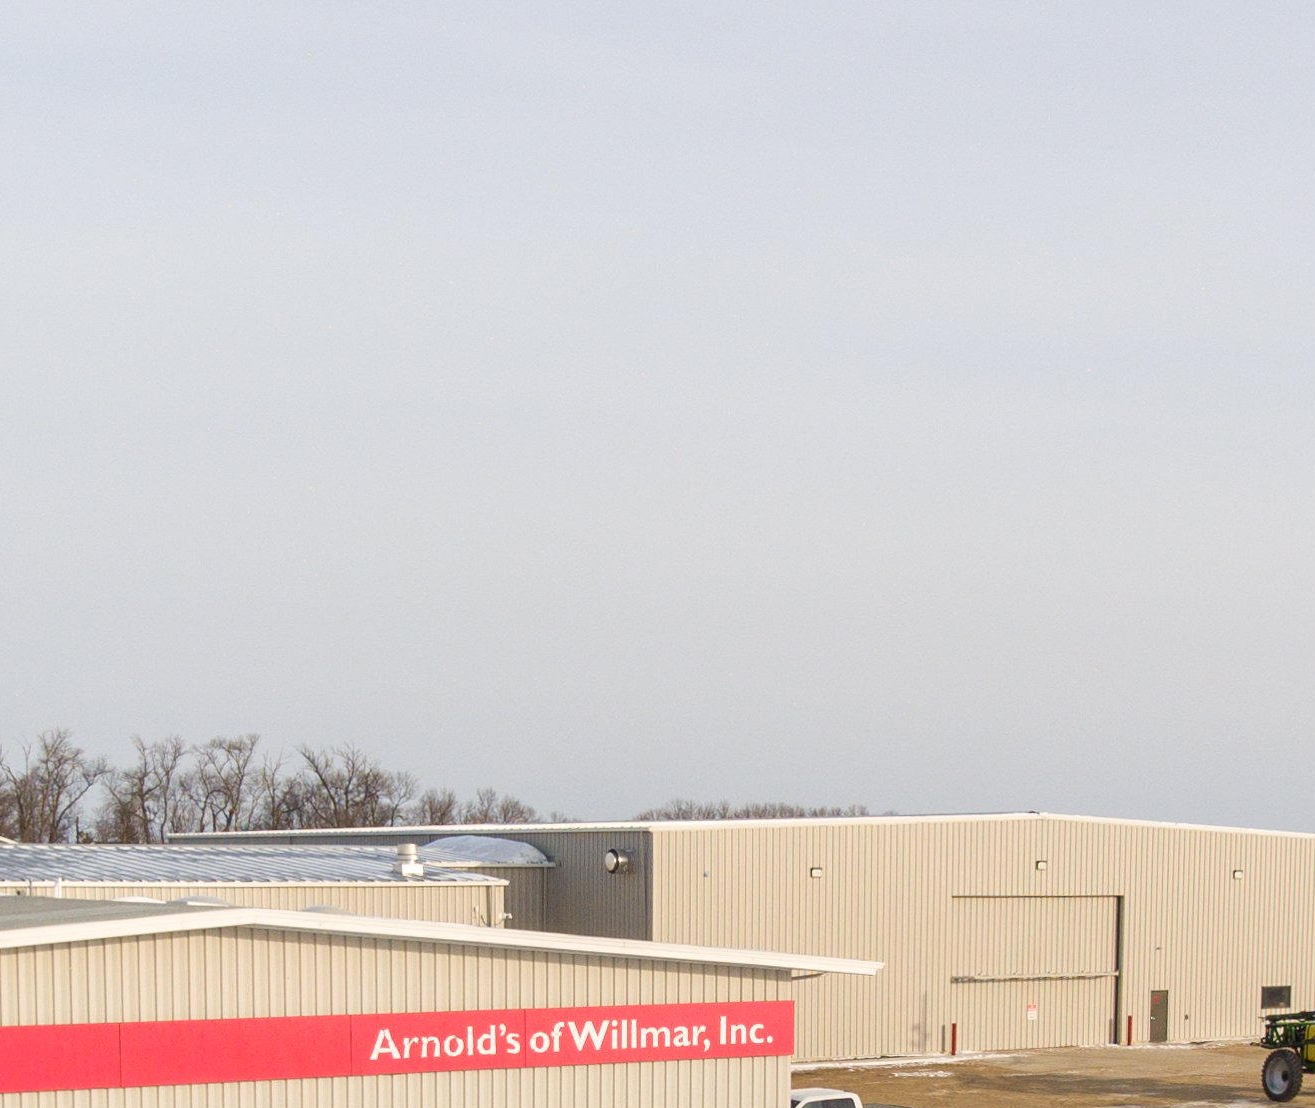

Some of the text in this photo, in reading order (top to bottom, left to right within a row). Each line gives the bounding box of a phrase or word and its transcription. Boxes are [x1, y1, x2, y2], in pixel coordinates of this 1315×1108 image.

[370, 1015, 774, 1062] Arnold's of Willmar, Inc.
